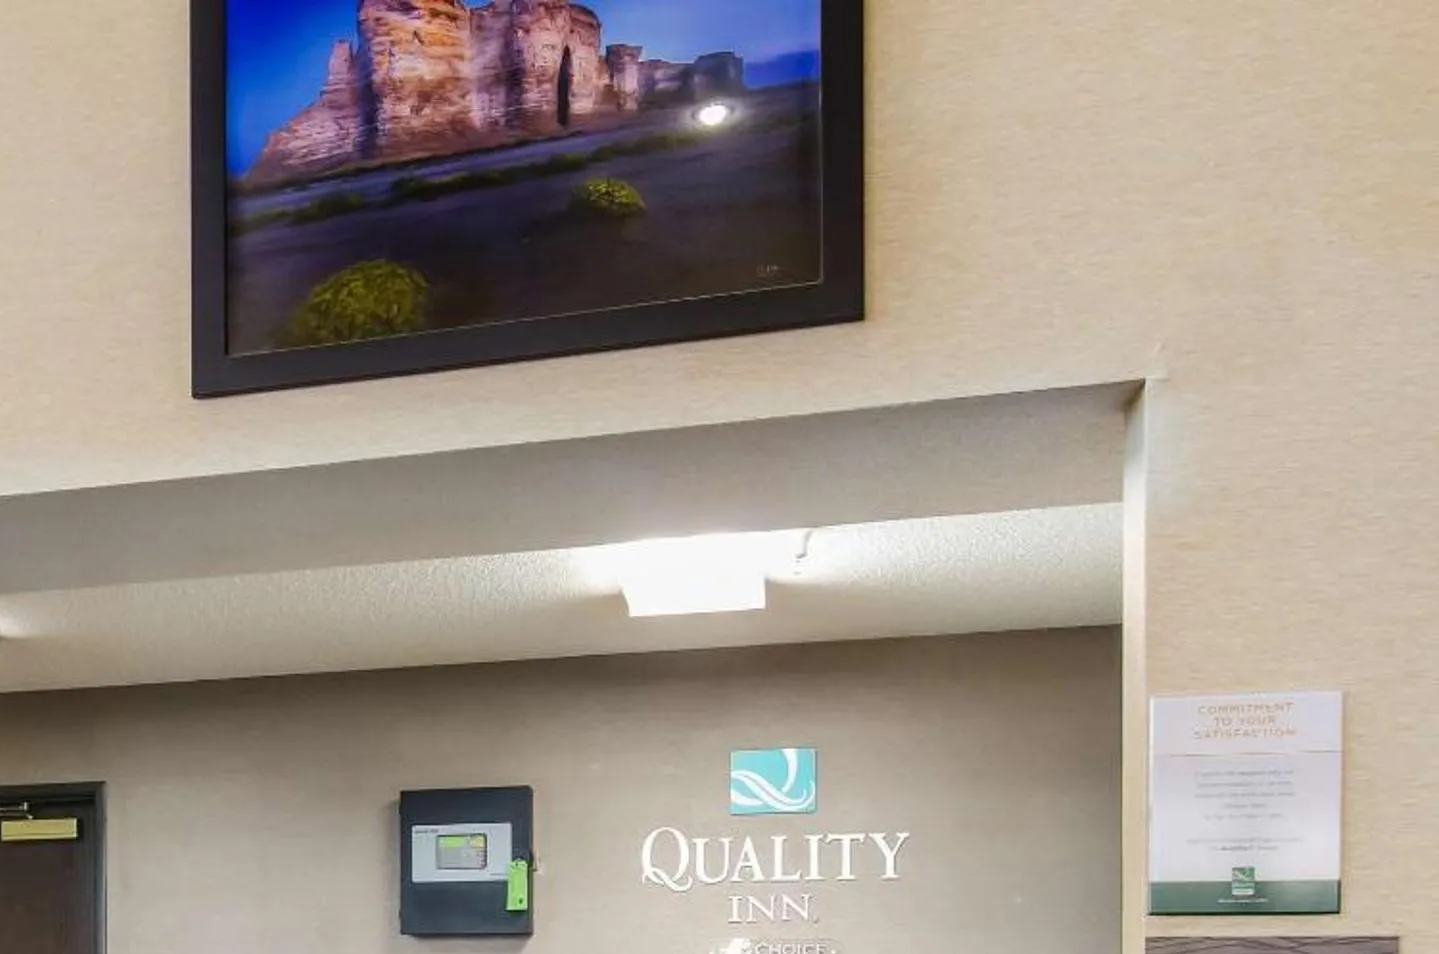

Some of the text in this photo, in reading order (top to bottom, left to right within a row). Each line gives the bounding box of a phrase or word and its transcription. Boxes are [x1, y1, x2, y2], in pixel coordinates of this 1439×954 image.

[1197, 702, 1295, 716] COMMITMENT
[1214, 715, 1277, 727] TO YOUR
[1192, 726, 1298, 740] SATISFACTION
[641, 826, 911, 892] QUALITY
[727, 893, 812, 924] INN
